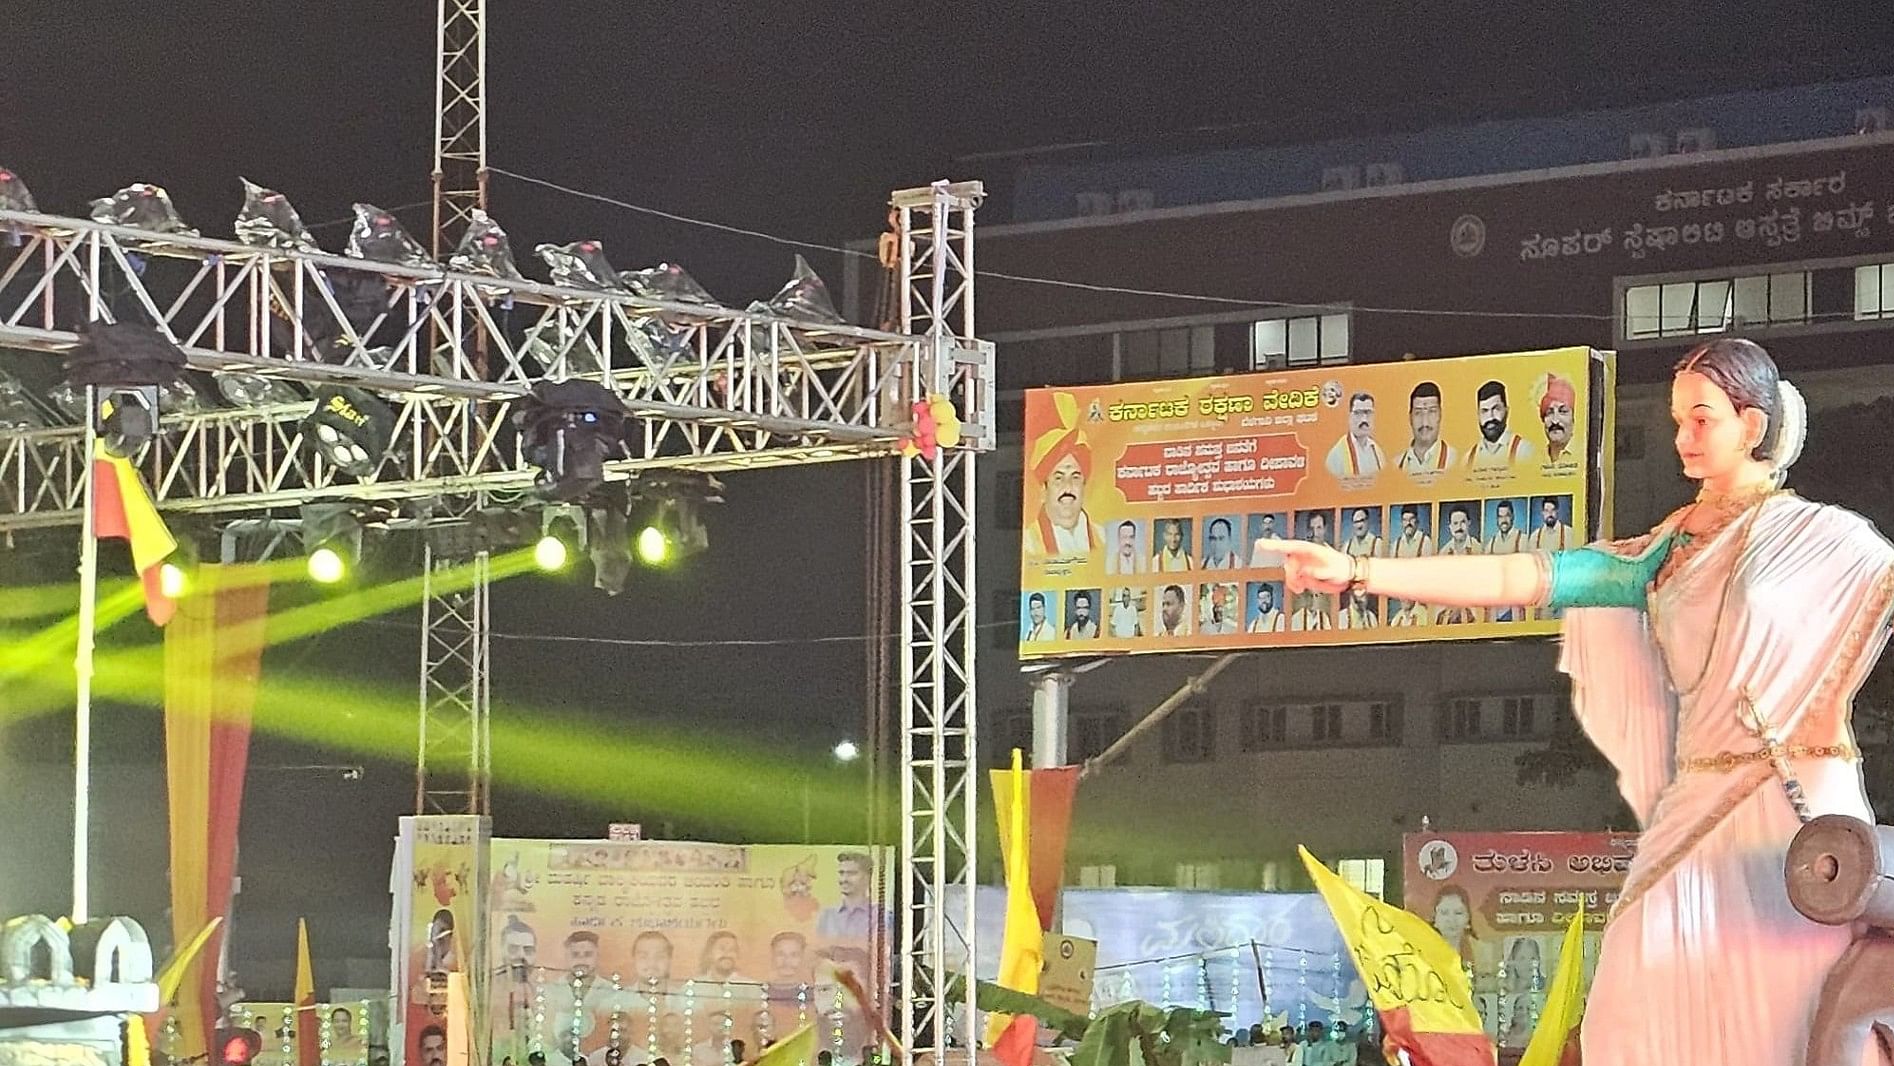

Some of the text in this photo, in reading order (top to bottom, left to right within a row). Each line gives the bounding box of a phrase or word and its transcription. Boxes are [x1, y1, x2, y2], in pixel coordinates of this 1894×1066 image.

[1109, 385, 1320, 422] ಕರ್ನಾಟಕ ರಕ್ಷಣಾ ವೇದಿಕೆ
